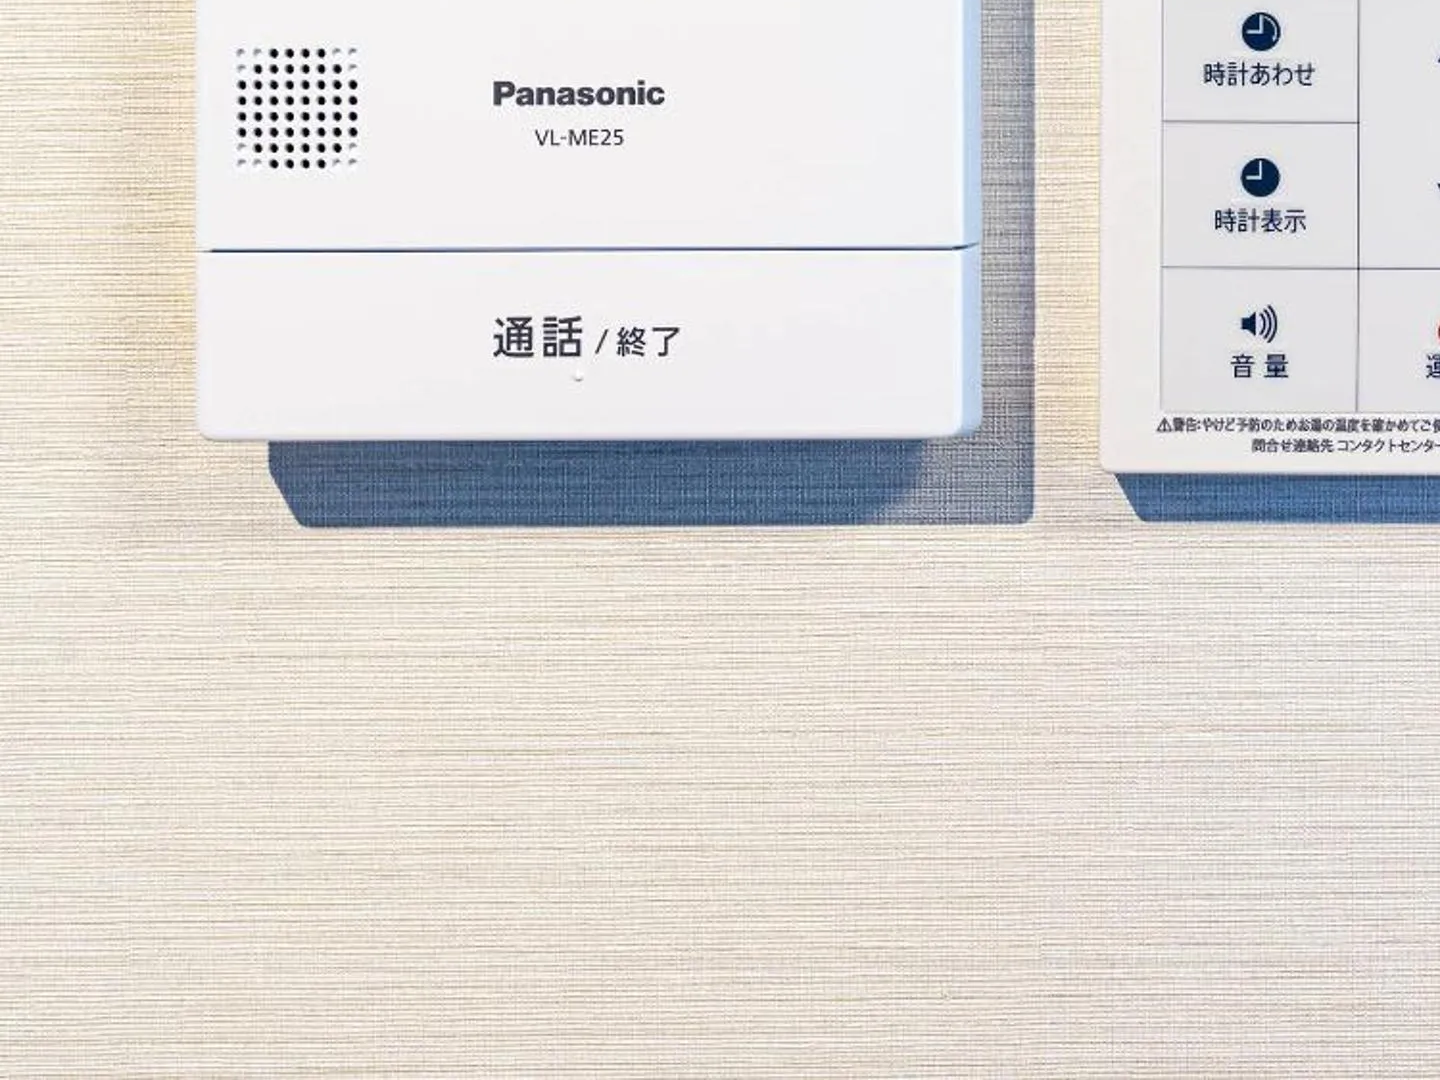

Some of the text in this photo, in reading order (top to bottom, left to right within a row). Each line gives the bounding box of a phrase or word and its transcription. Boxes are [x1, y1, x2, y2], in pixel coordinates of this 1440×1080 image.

[1203, 62, 1316, 87] 時計あわせ
[493, 79, 666, 107] Panasonic
[534, 128, 625, 147] VL-ME25
[1214, 207, 1307, 234] 時計表示
